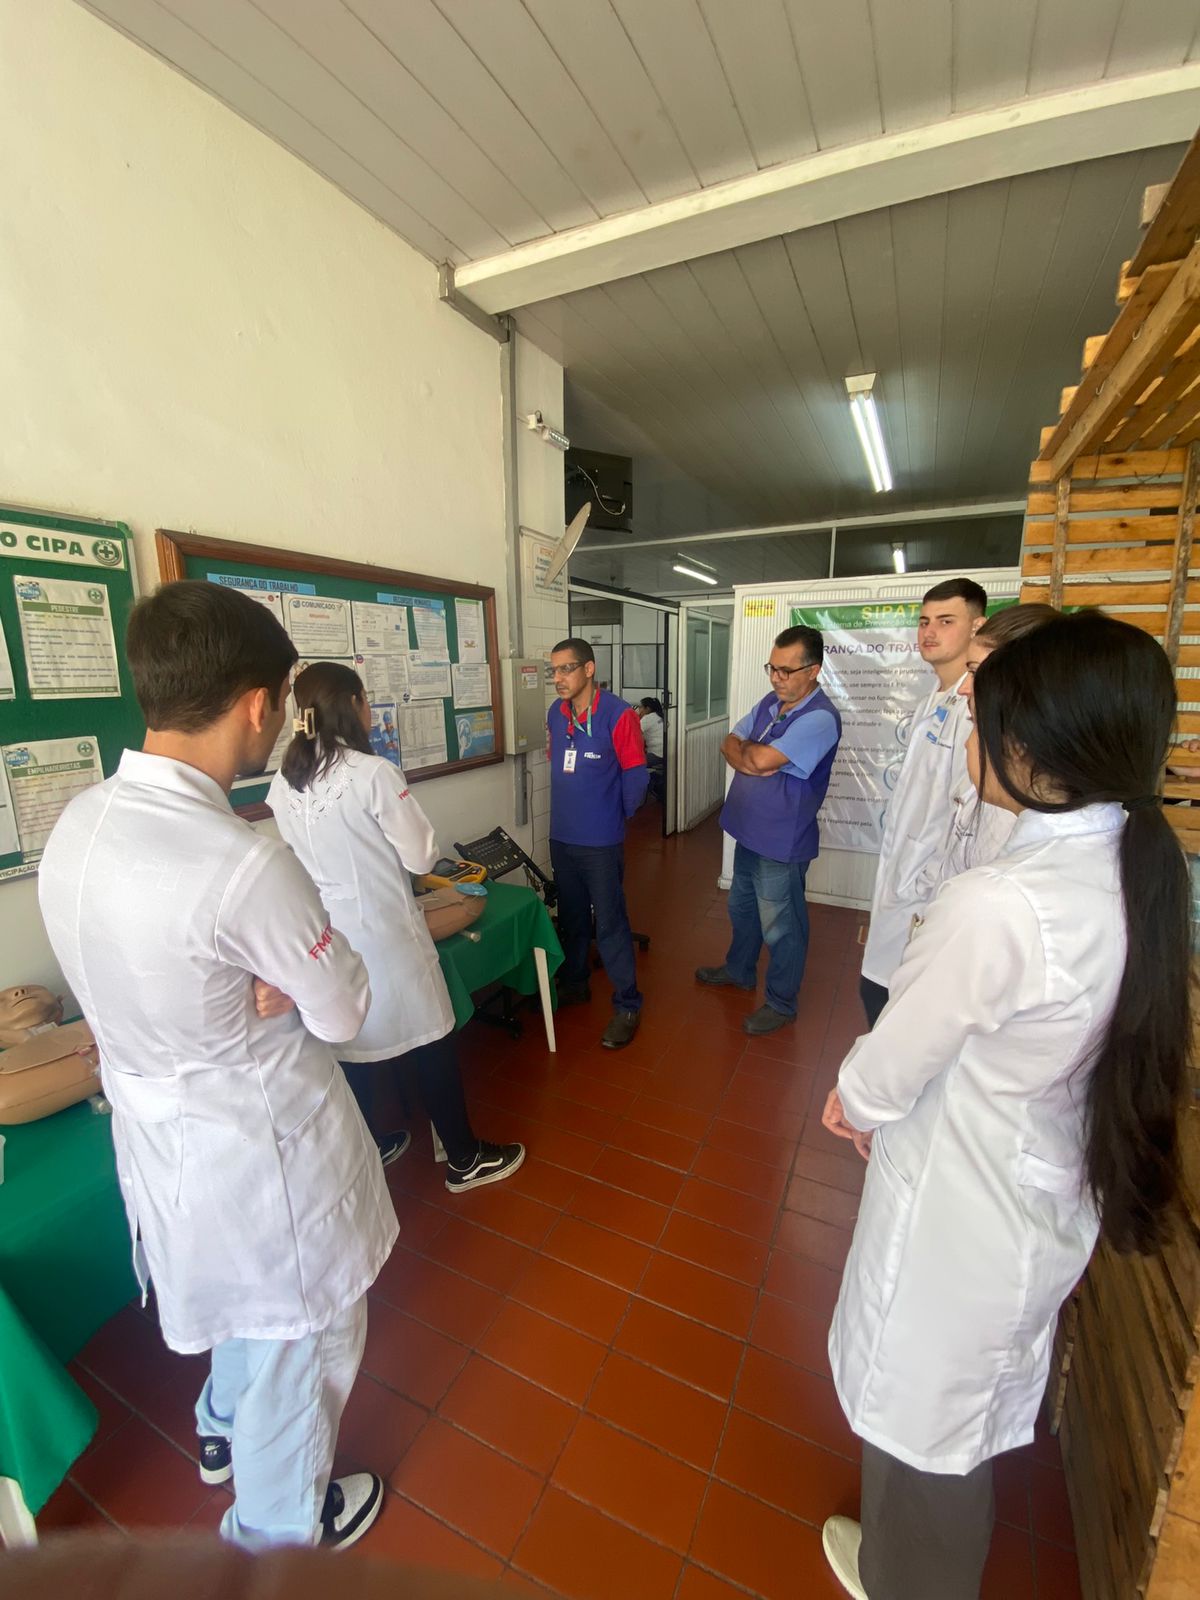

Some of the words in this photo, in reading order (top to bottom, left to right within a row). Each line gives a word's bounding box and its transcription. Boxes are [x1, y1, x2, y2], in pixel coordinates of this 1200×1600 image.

[26, 535, 85, 556] CIPA
[218, 576, 258, 589] SEGURANÇA
[259, 580, 268, 590] DO
[269, 581, 299, 593] TRABALHO
[867, 643, 885, 654] DO
